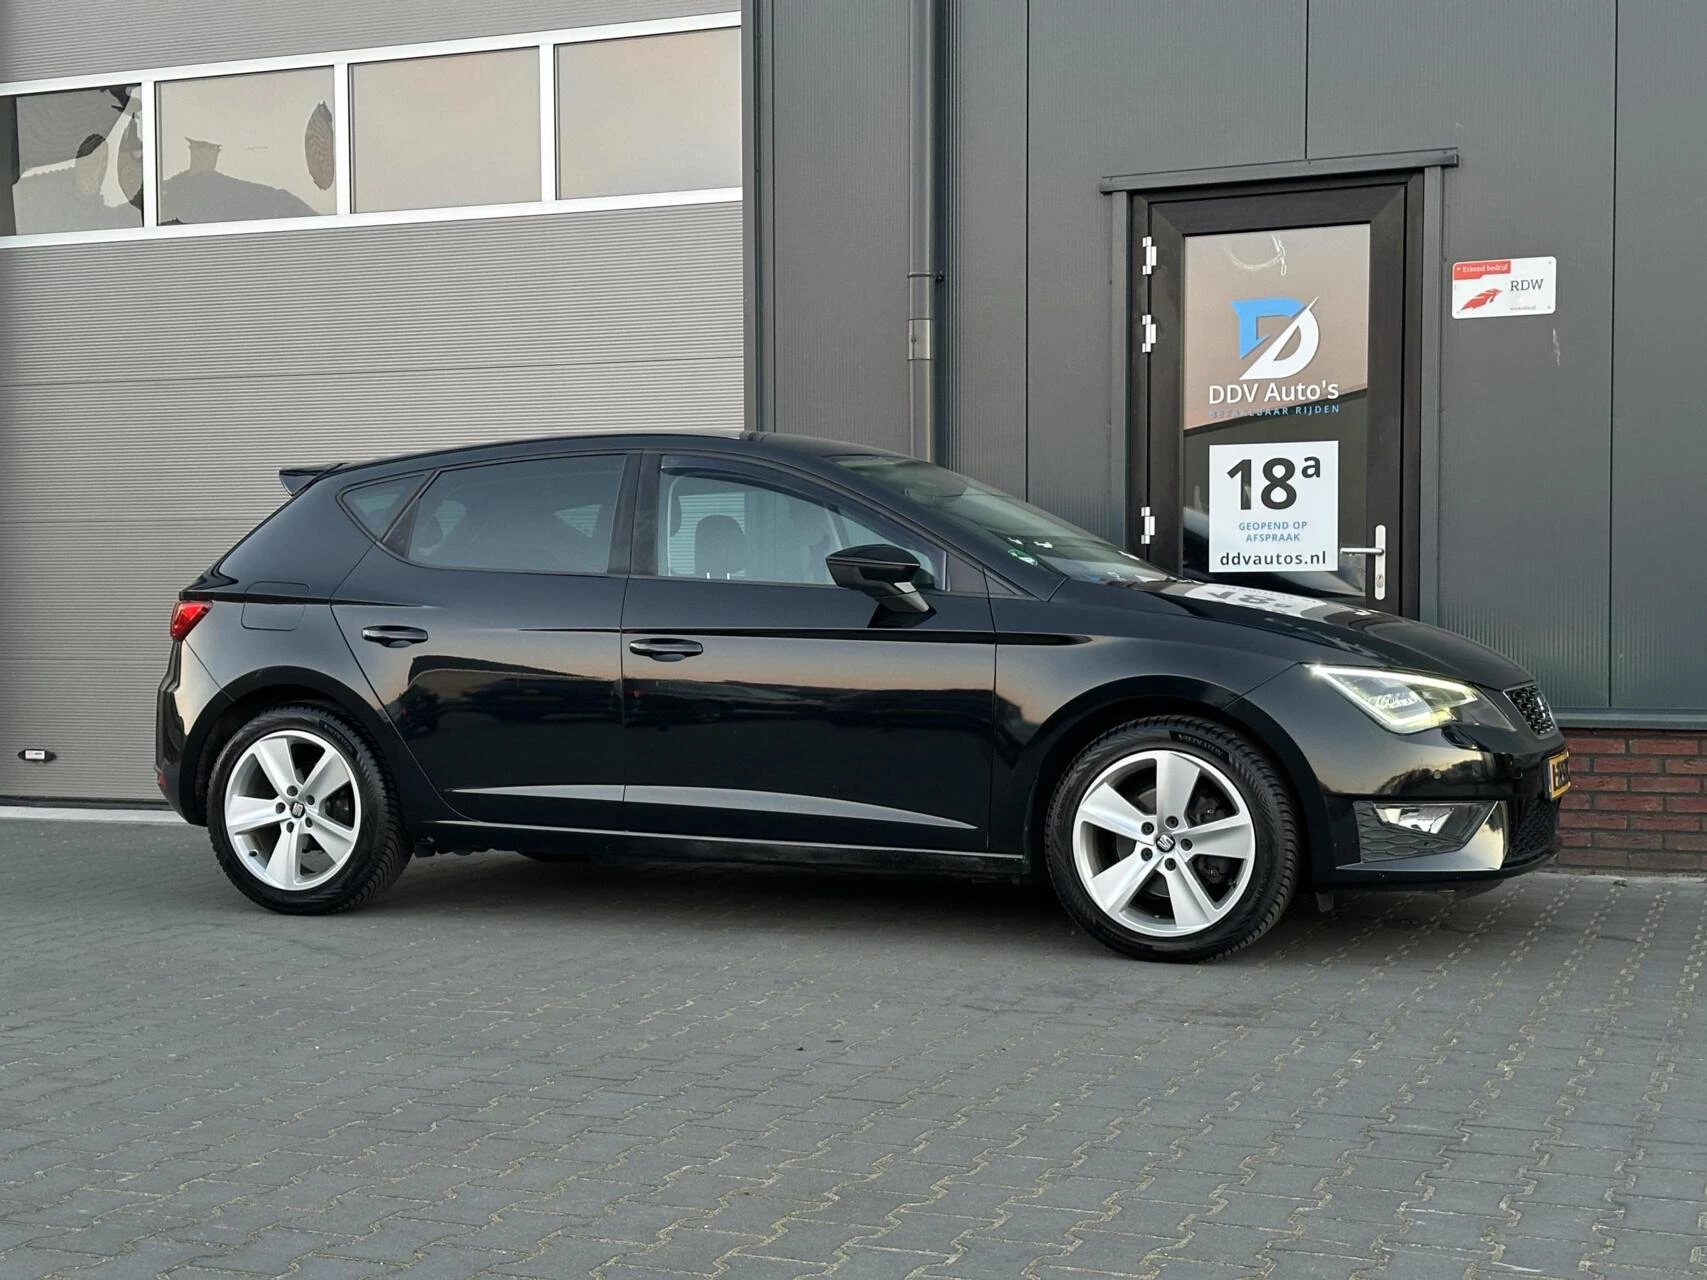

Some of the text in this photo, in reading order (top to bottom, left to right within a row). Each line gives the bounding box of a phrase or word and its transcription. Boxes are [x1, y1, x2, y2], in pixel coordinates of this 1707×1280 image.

[1510, 278, 1544, 292] RDW
[1208, 380, 1340, 405] DDV Auto's
[1295, 405, 1340, 416] RIJDEN
[1238, 520, 1308, 531] GEOPEND OP
[1245, 533, 1301, 543] AFSPRAAK
[1220, 550, 1327, 566] ddvautos.nl
